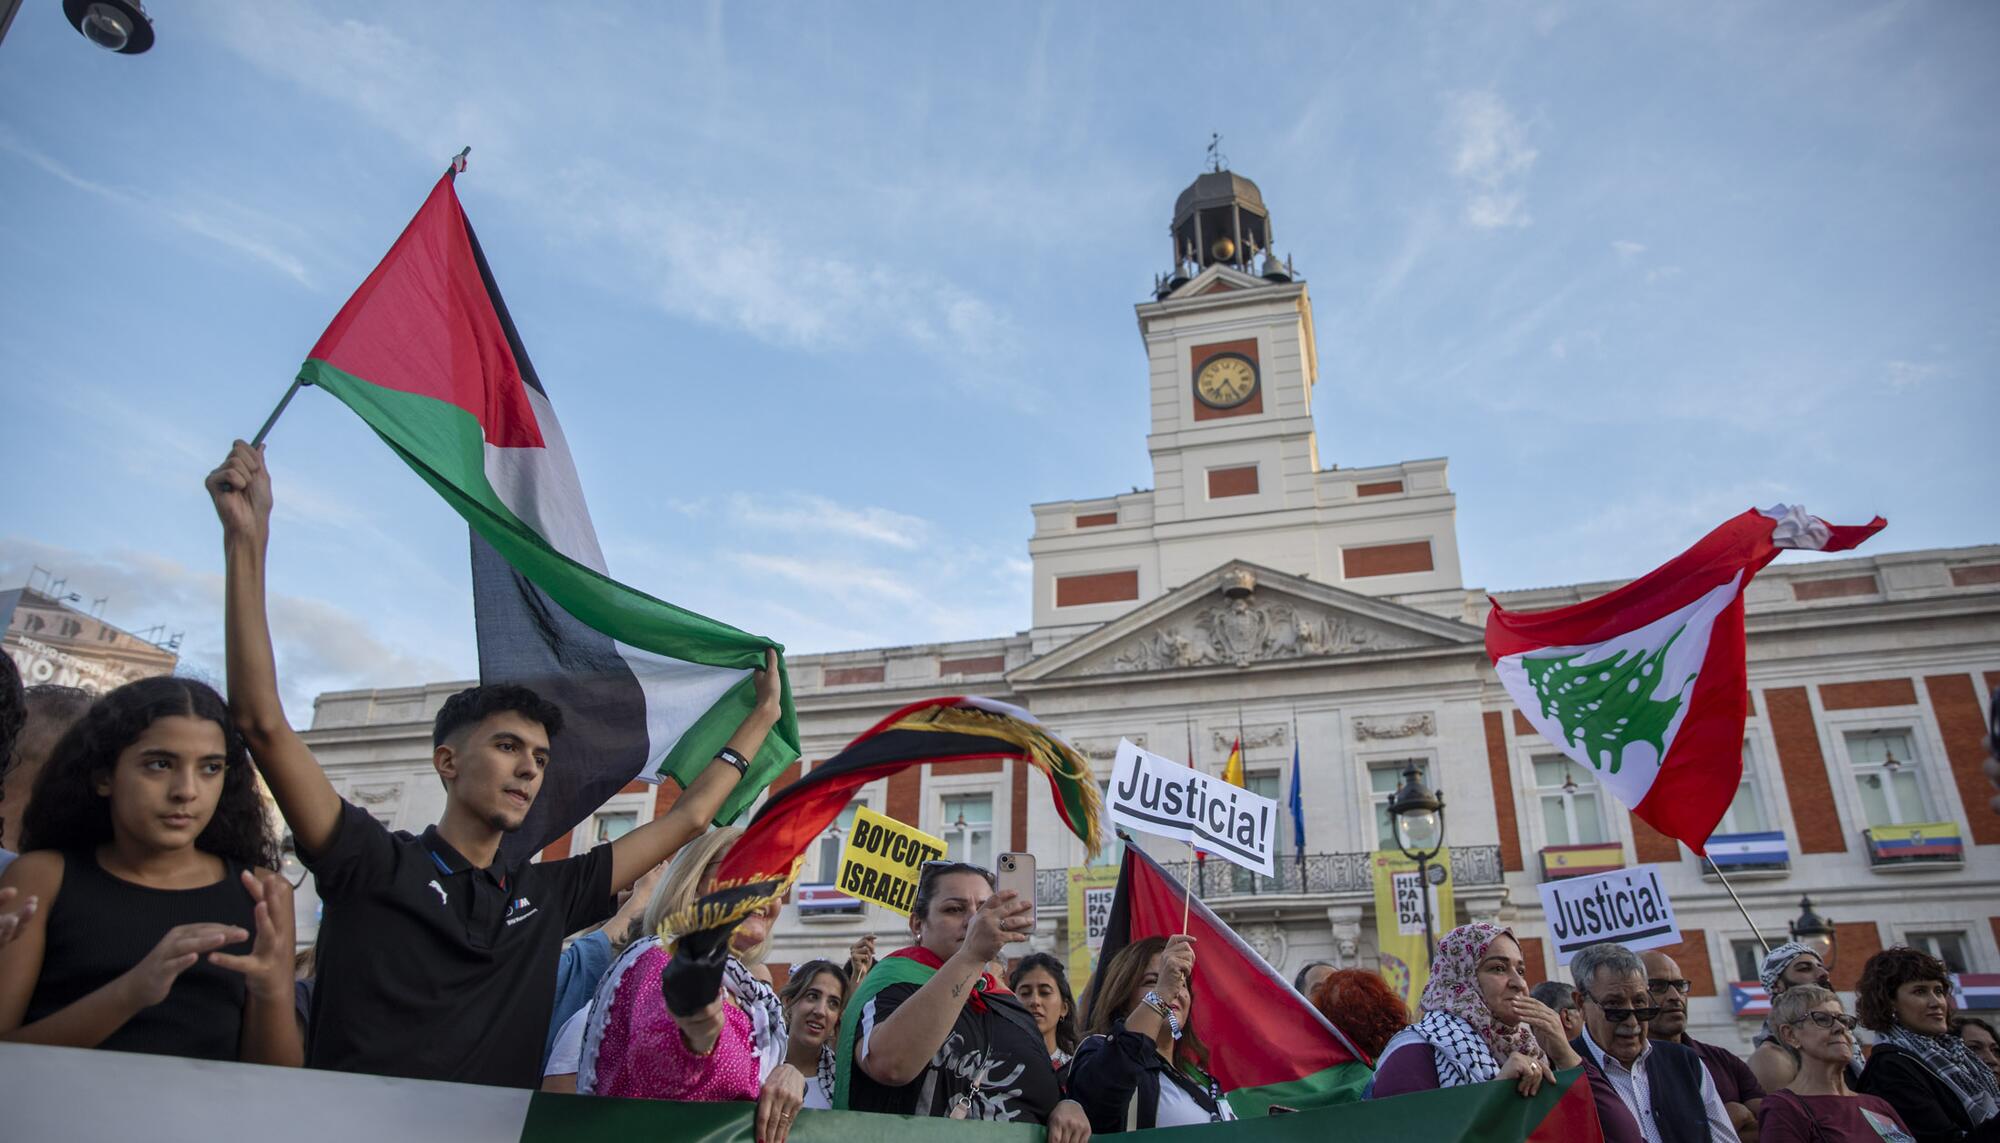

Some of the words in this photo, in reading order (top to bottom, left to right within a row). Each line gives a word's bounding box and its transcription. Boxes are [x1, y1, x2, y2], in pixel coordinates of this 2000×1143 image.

[1118, 756, 1268, 853] Justicia!
[1088, 893, 1112, 903] HIS
[1398, 890, 1418, 900] PA
[1088, 905, 1107, 914] PA
[1399, 901, 1415, 912] NI
[1553, 872, 1668, 939] Justicia!
[1089, 916, 1104, 926] NI
